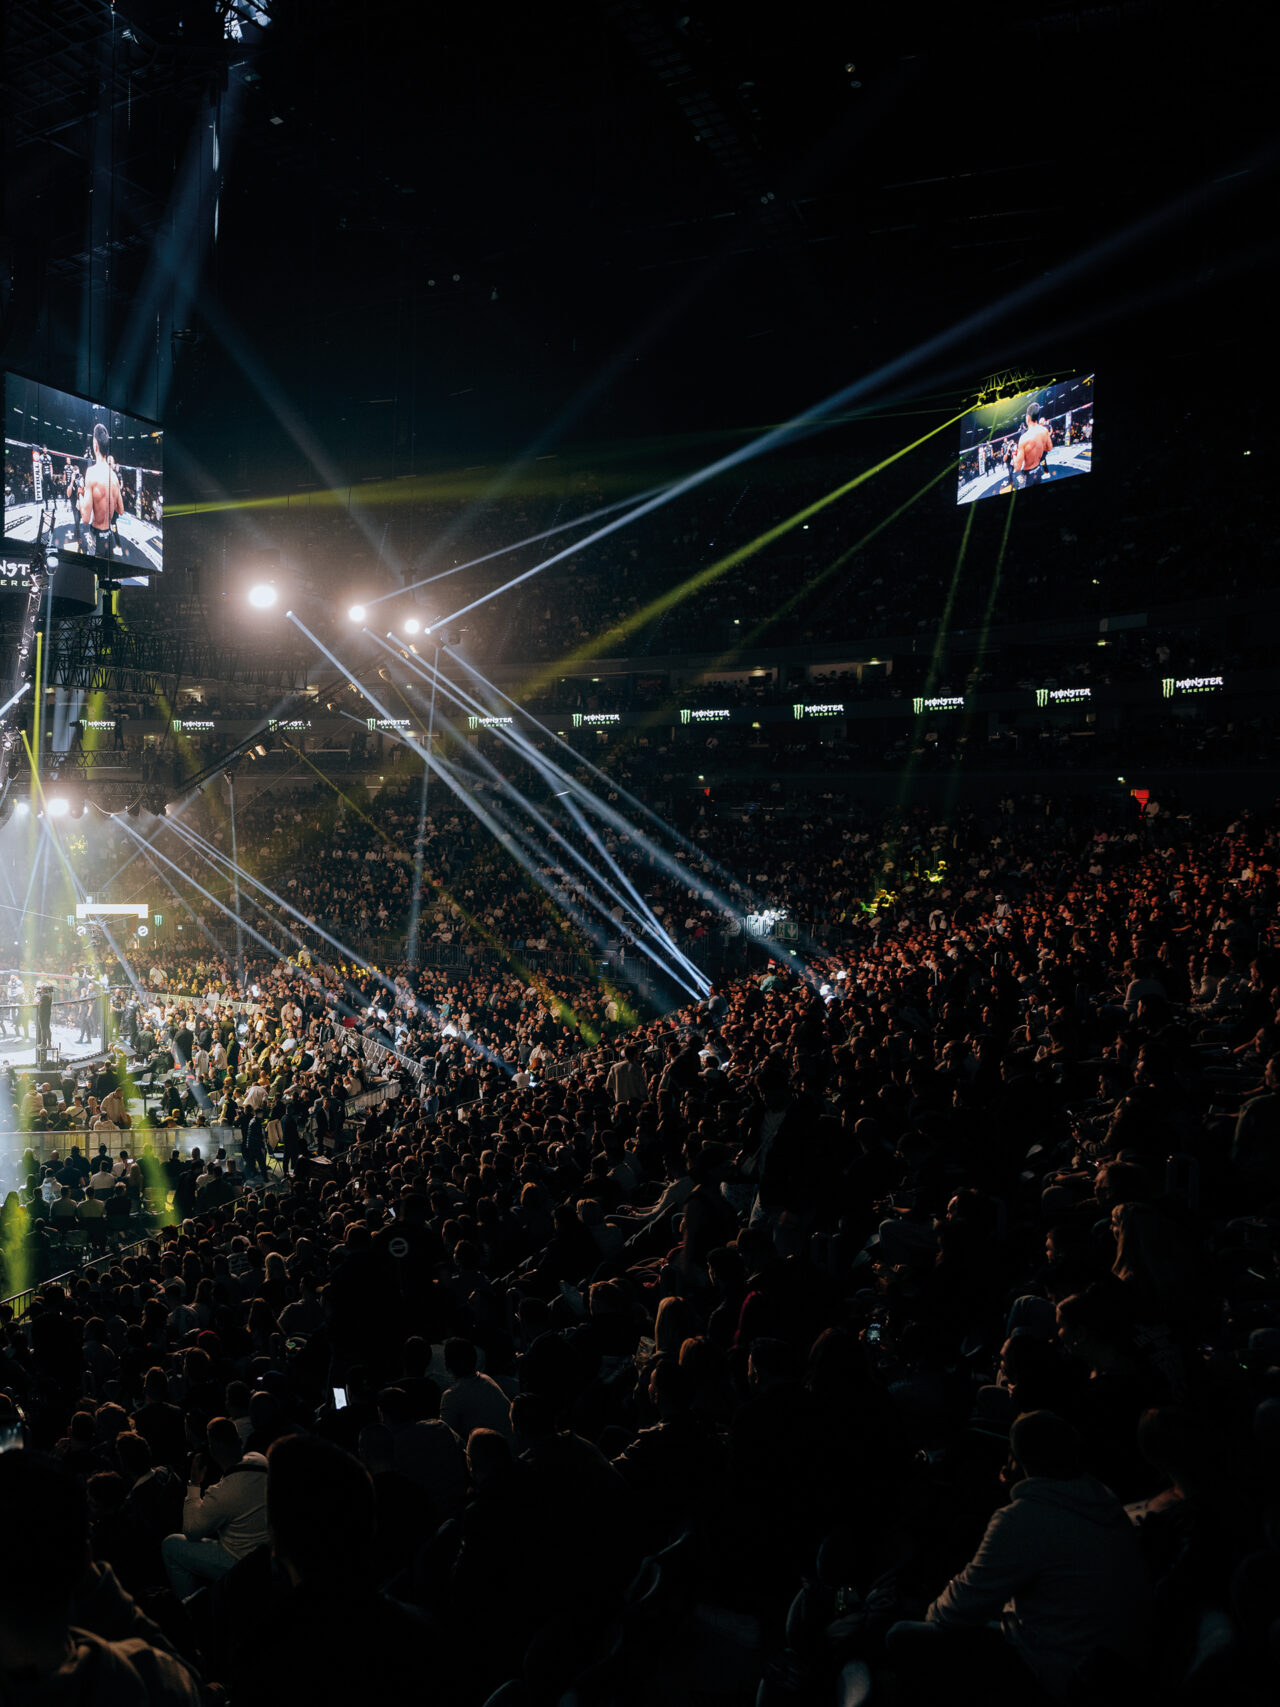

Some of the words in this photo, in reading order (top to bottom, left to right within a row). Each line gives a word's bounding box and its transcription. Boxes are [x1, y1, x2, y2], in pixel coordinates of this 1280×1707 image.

[1175, 676, 1224, 688] MONSTER
[1049, 688, 1091, 699] MONSTER
[924, 697, 964, 707] MONSTER
[691, 709, 730, 718] MONSTER
[804, 704, 844, 714] MONSTER
[583, 714, 620, 722] MONSTER
